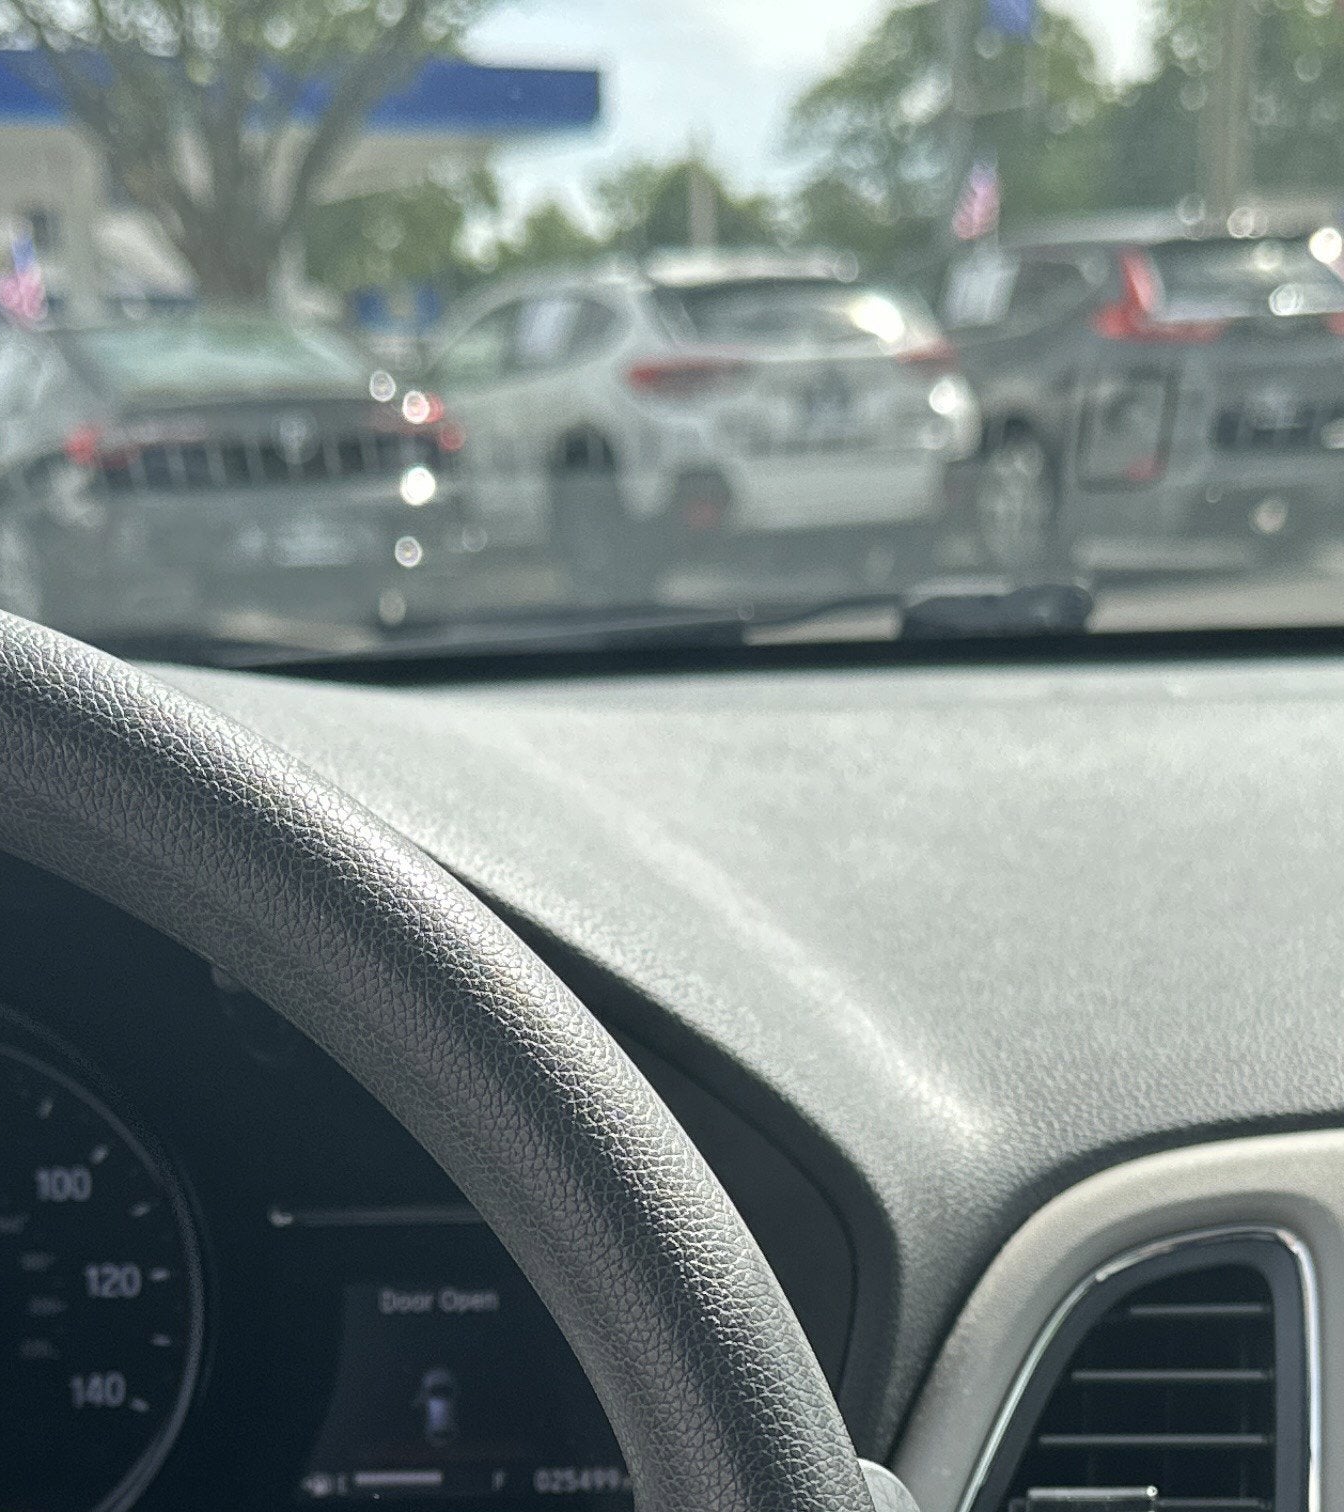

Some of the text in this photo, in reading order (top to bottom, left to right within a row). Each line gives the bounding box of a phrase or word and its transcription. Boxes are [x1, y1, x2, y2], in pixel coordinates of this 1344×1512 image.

[33, 1166, 91, 1202] 100
[84, 1264, 142, 1299] 120
[379, 1287, 499, 1314] Door Open
[70, 1374, 127, 1409] 140
